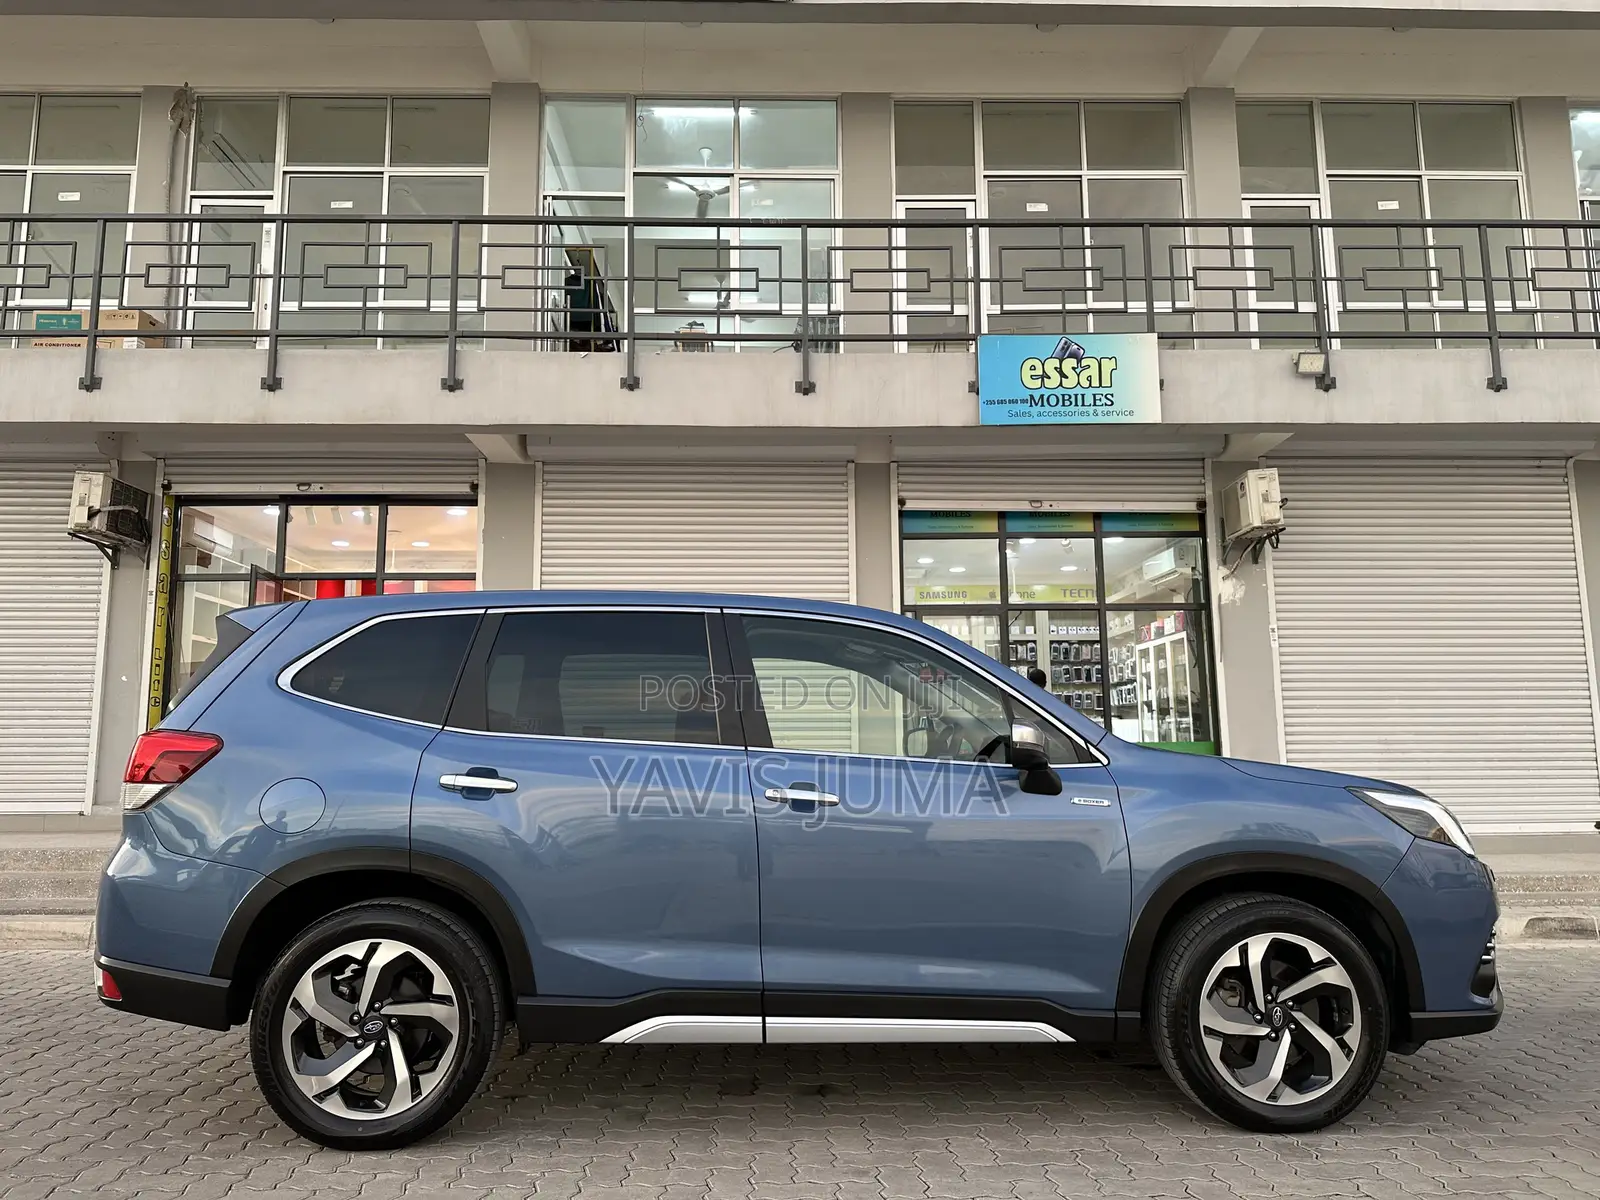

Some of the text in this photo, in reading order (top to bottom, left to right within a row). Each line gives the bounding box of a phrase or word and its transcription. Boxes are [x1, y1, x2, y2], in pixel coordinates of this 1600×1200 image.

[1020, 356, 1118, 389] essar
[1028, 393, 1114, 408] MOBILES
[1007, 408, 1135, 418] Sales, accessories & service
[919, 590, 968, 600] SAMSUNG
[1060, 588, 1098, 599] TECN
